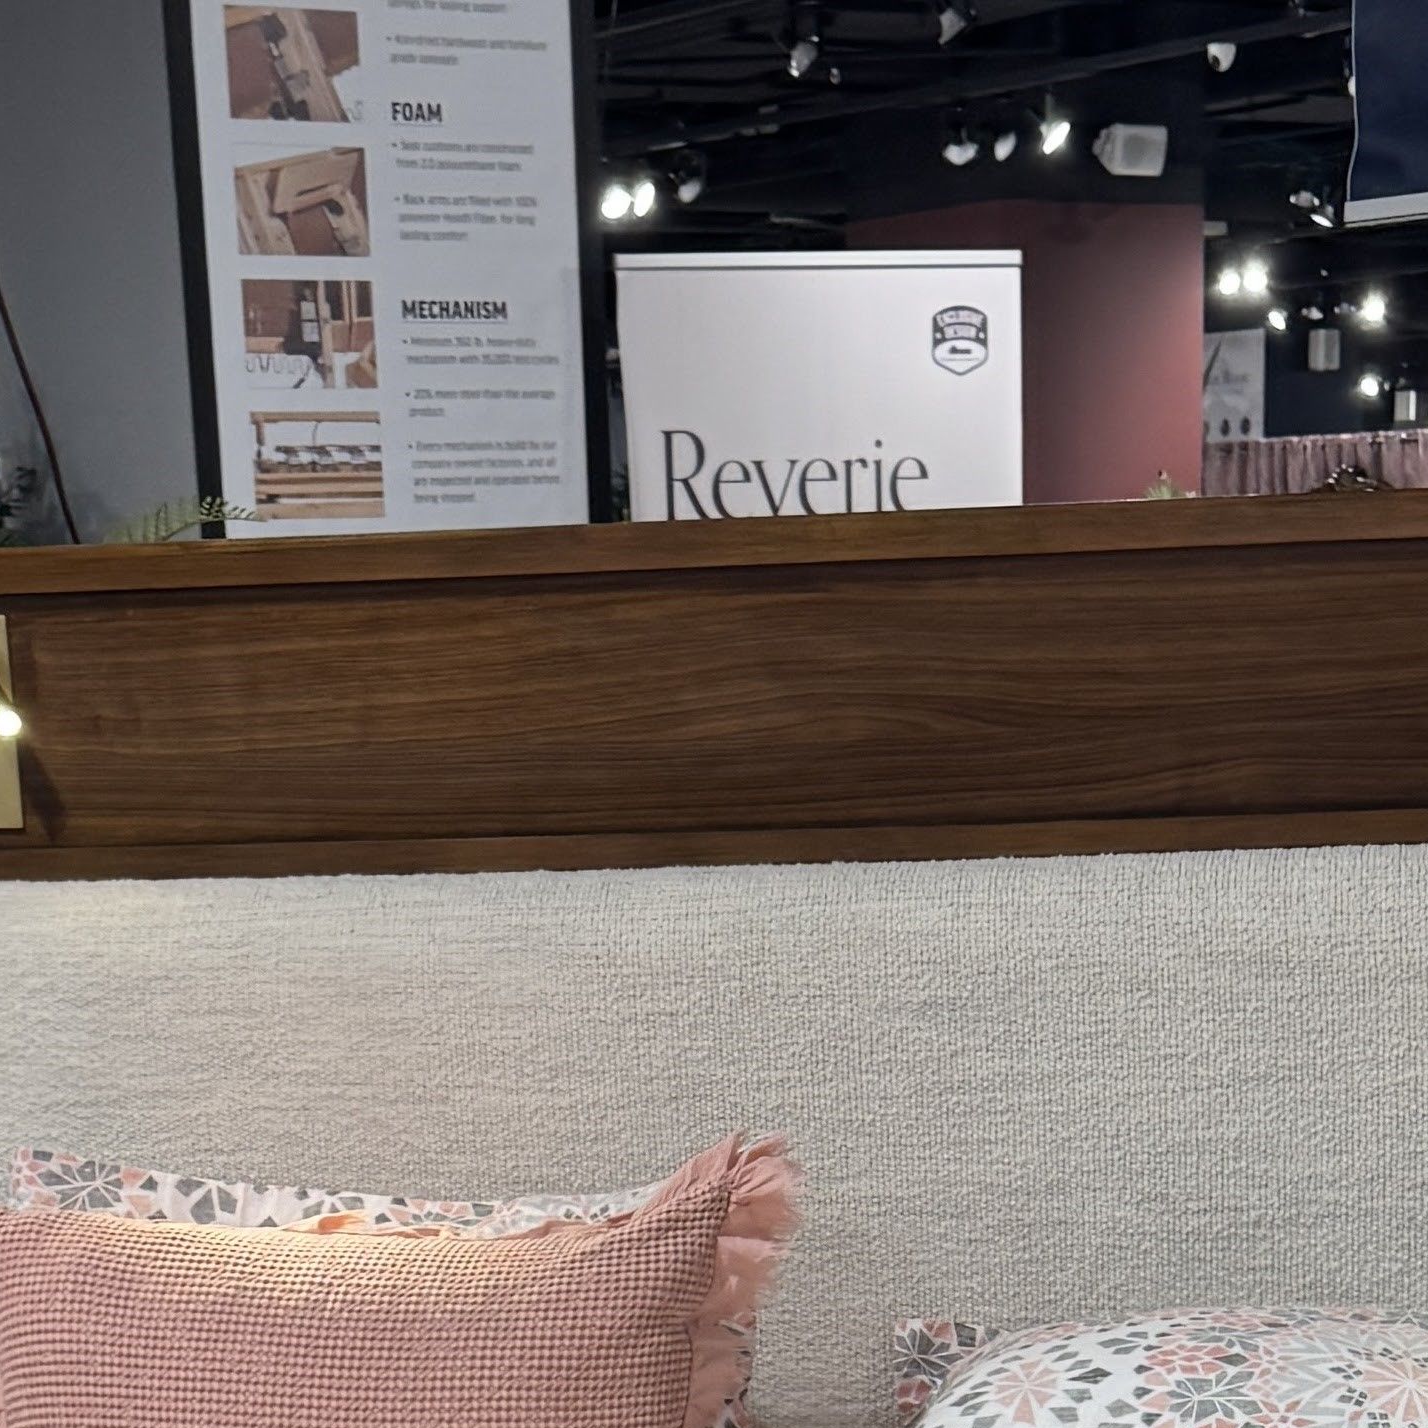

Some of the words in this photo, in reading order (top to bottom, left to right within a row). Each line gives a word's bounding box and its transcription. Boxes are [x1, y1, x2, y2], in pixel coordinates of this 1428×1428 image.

[390, 101, 443, 123] FOAM
[400, 299, 509, 320] MECHANISM
[661, 429, 929, 521] Reverie
